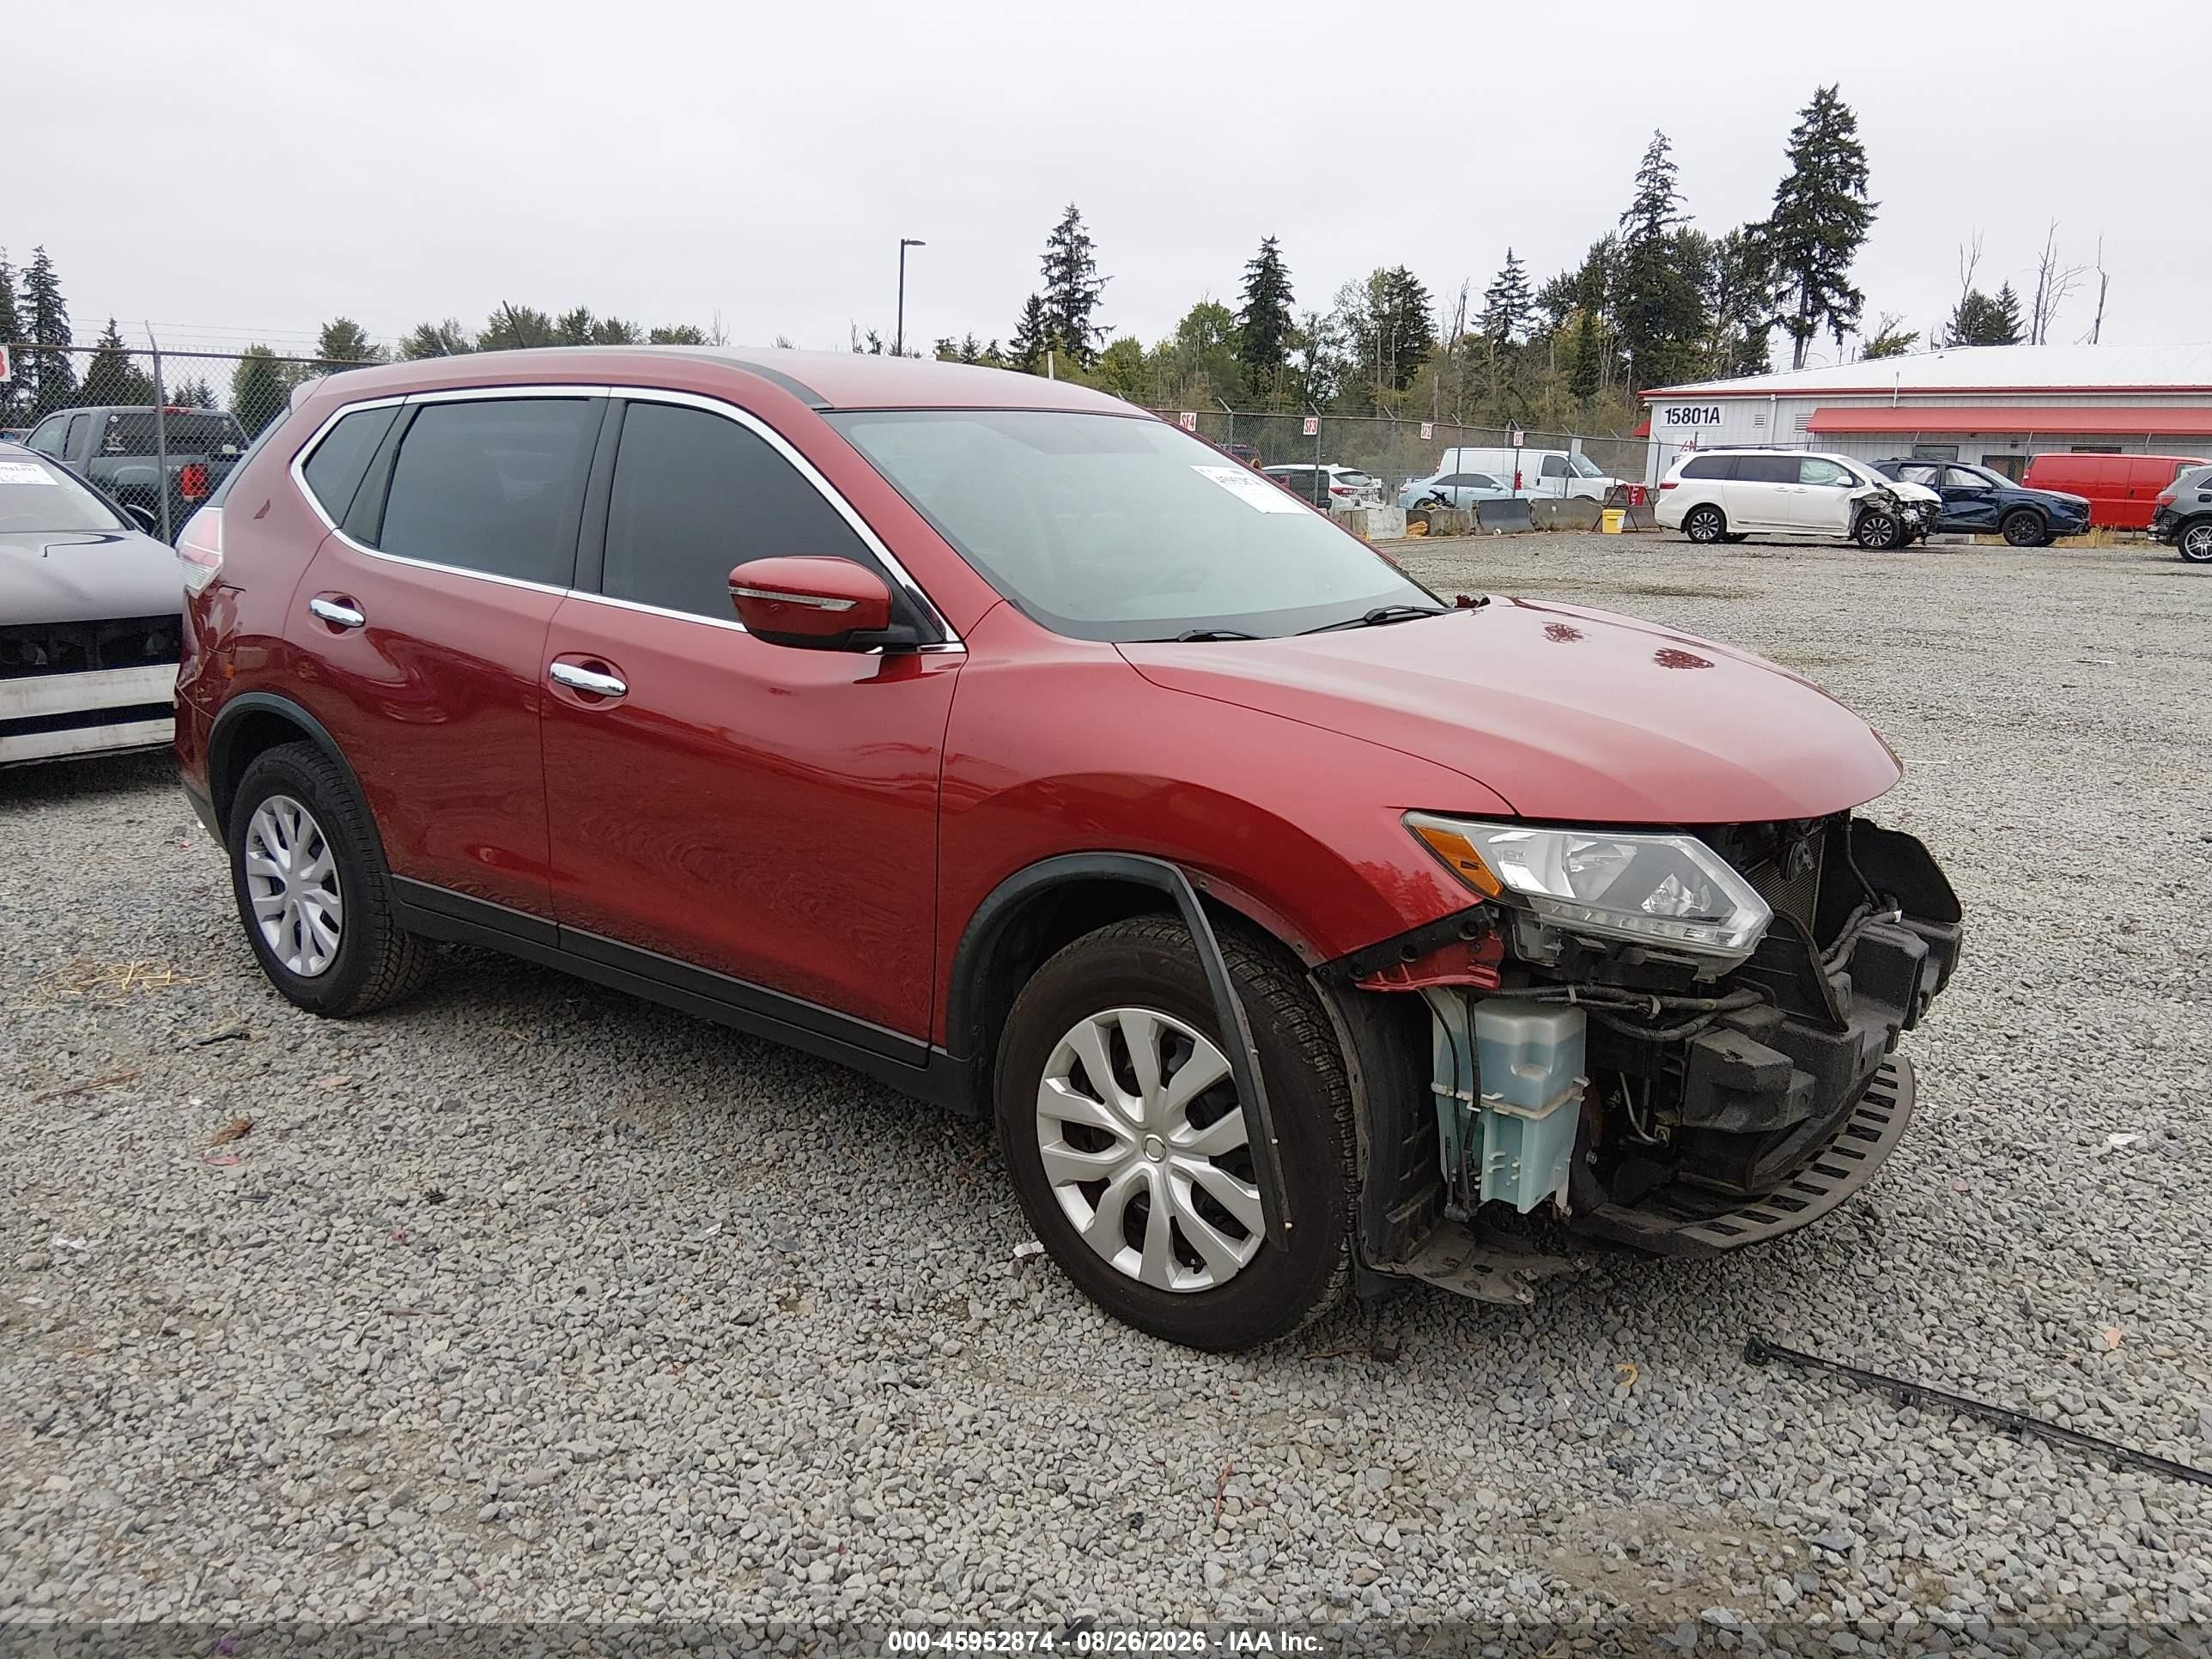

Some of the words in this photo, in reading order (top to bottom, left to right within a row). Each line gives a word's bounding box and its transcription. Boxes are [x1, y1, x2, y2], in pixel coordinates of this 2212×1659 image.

[1181, 414, 1195, 429] SF4
[1664, 406, 1720, 424] 15801A
[1304, 419, 1317, 434] SF3
[1421, 424, 1431, 438] SF2
